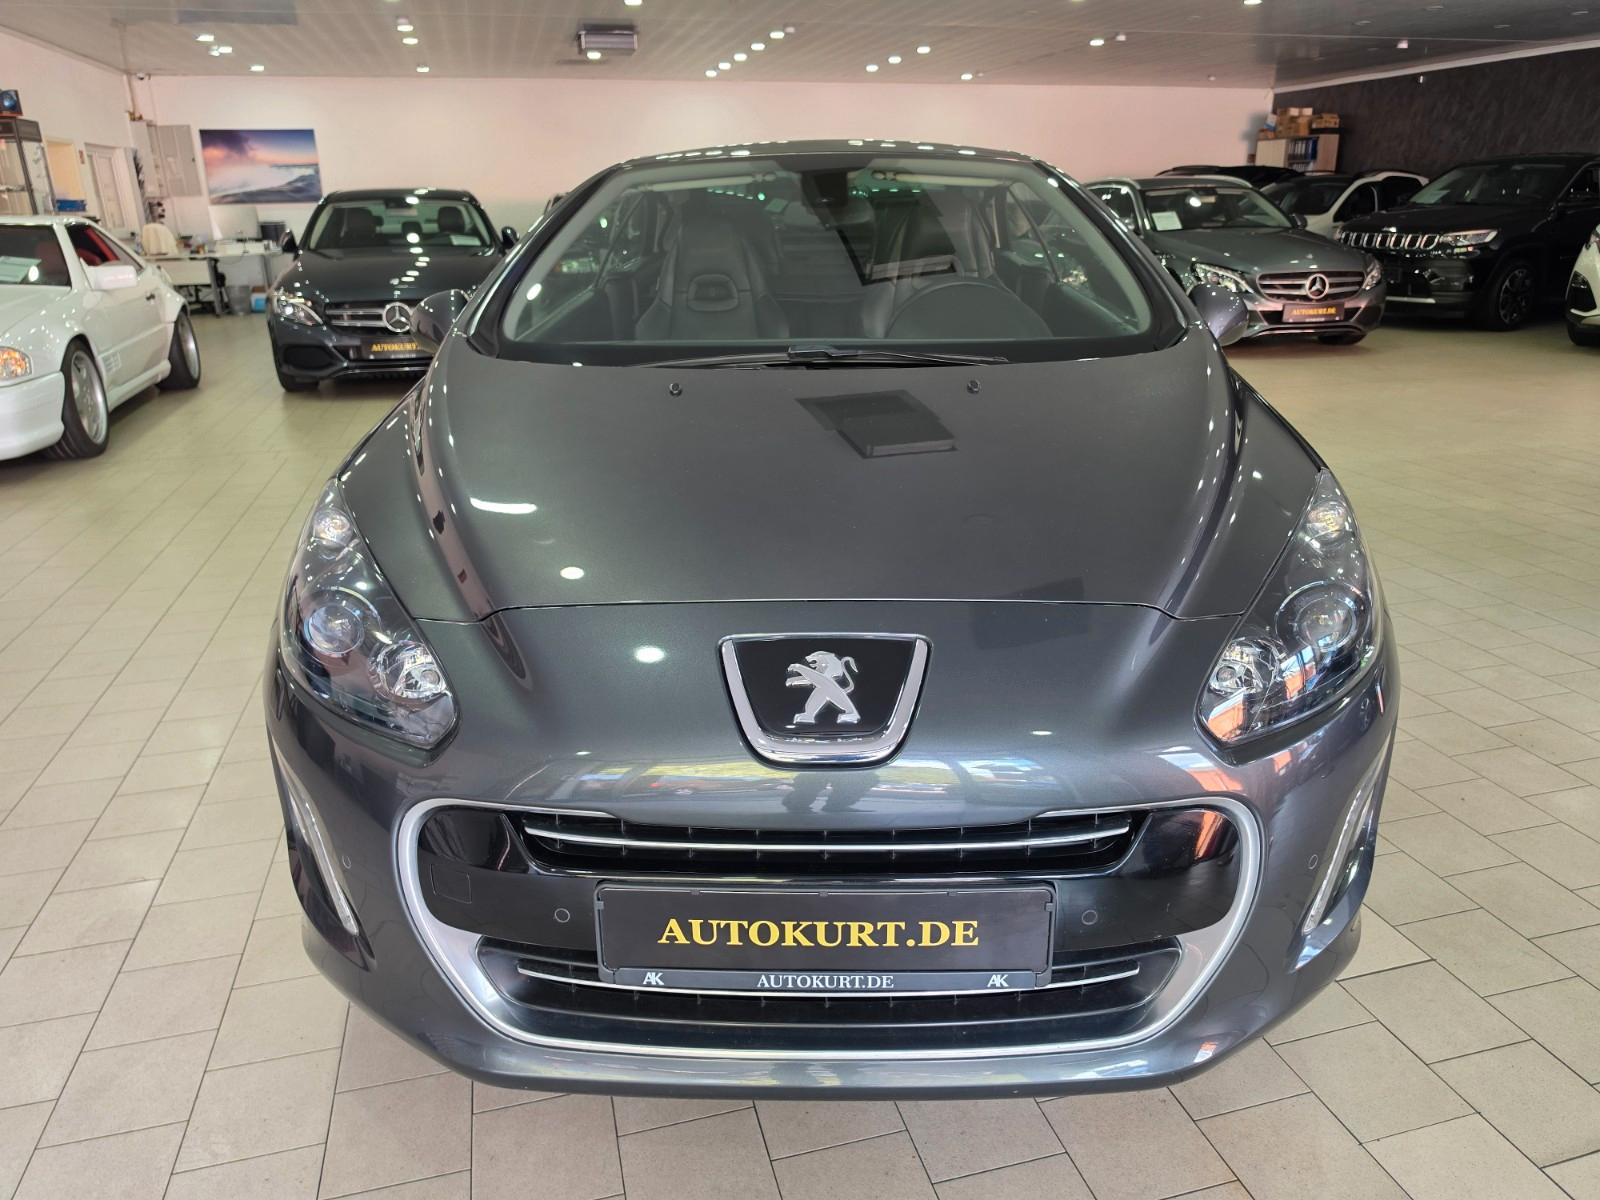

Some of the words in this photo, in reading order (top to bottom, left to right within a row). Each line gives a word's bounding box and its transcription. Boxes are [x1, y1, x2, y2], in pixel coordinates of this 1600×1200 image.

[657, 918, 980, 947] AUTOKURT.DE
[643, 972, 665, 986] AK
[757, 974, 895, 989] AUTOKURT.DE
[987, 974, 1009, 988] AK
